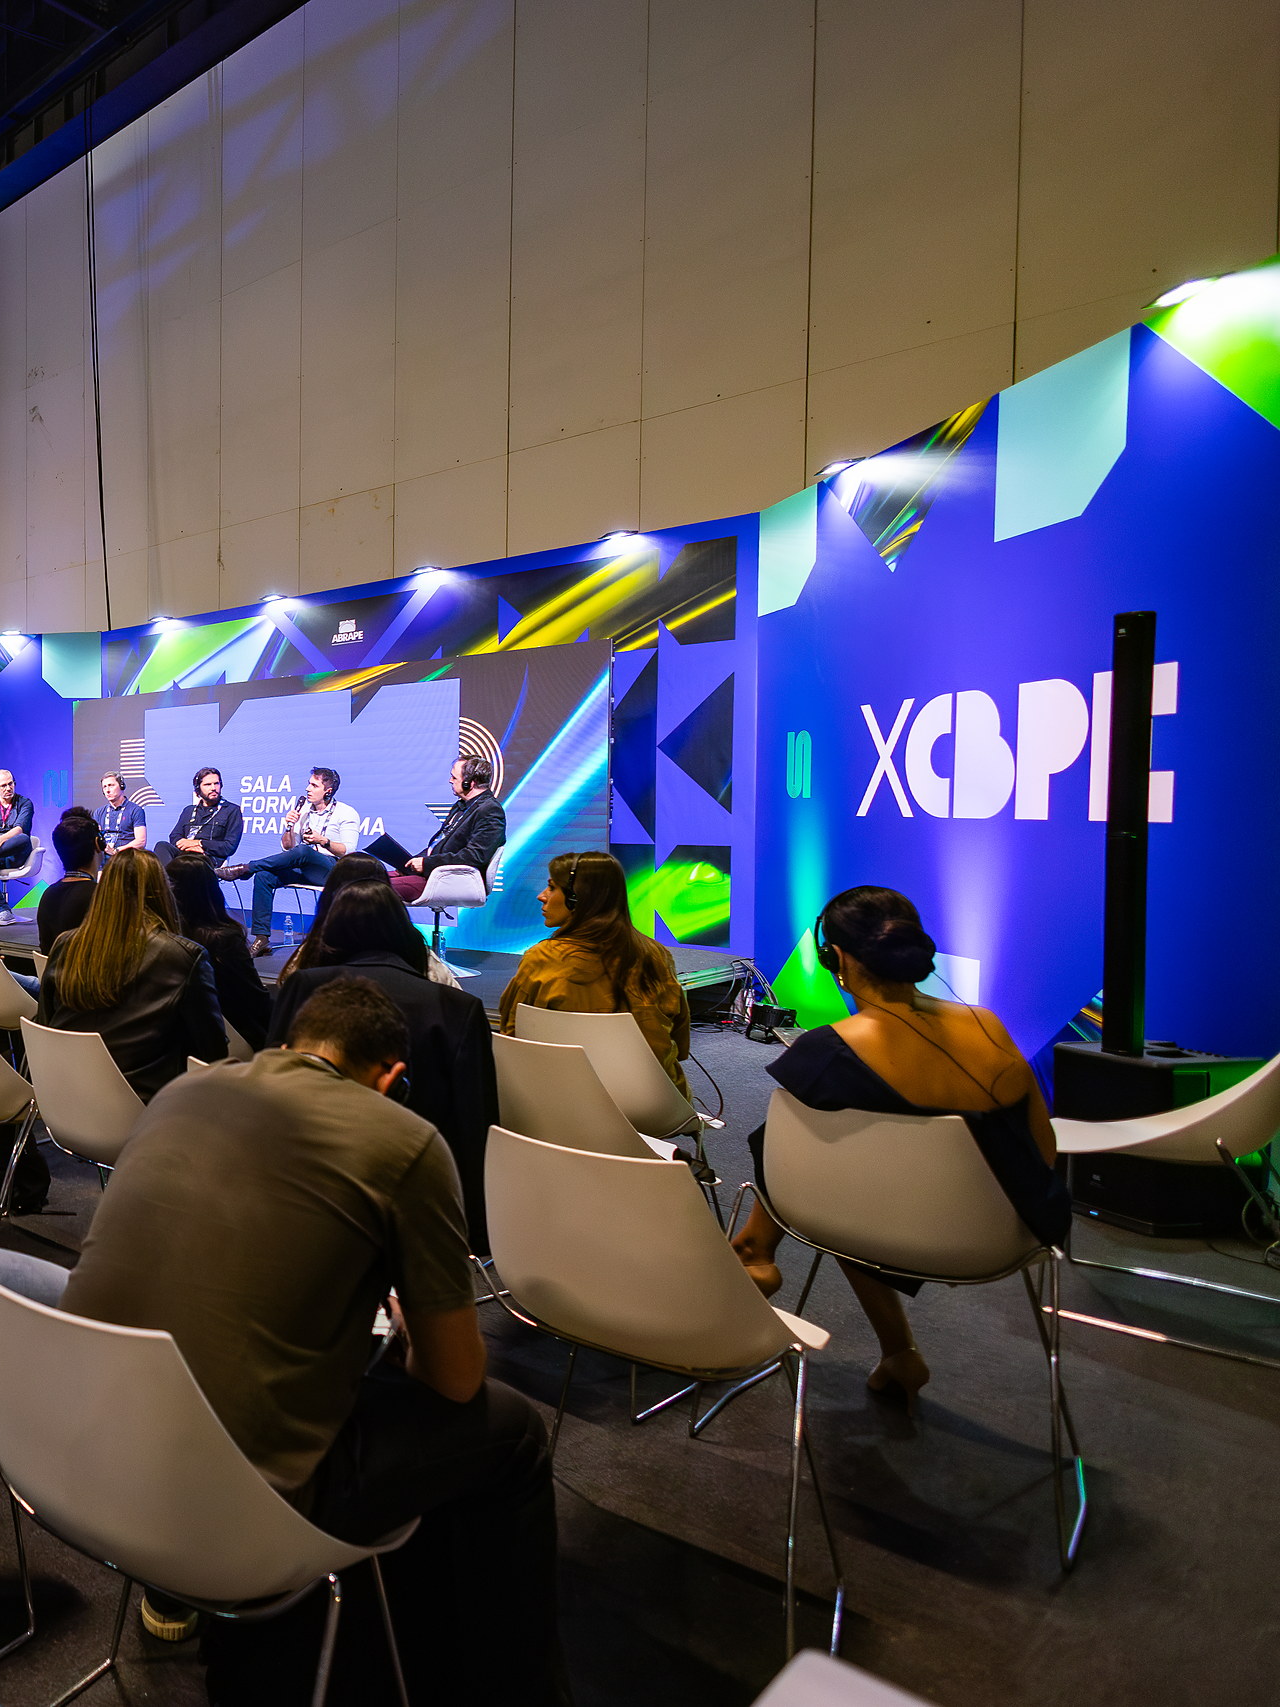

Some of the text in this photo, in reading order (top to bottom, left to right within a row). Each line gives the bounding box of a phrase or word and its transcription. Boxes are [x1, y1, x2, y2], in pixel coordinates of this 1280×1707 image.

[332, 631, 364, 643] ABRAPE
[240, 775, 292, 793] SALA
[240, 796, 297, 813] FORM
